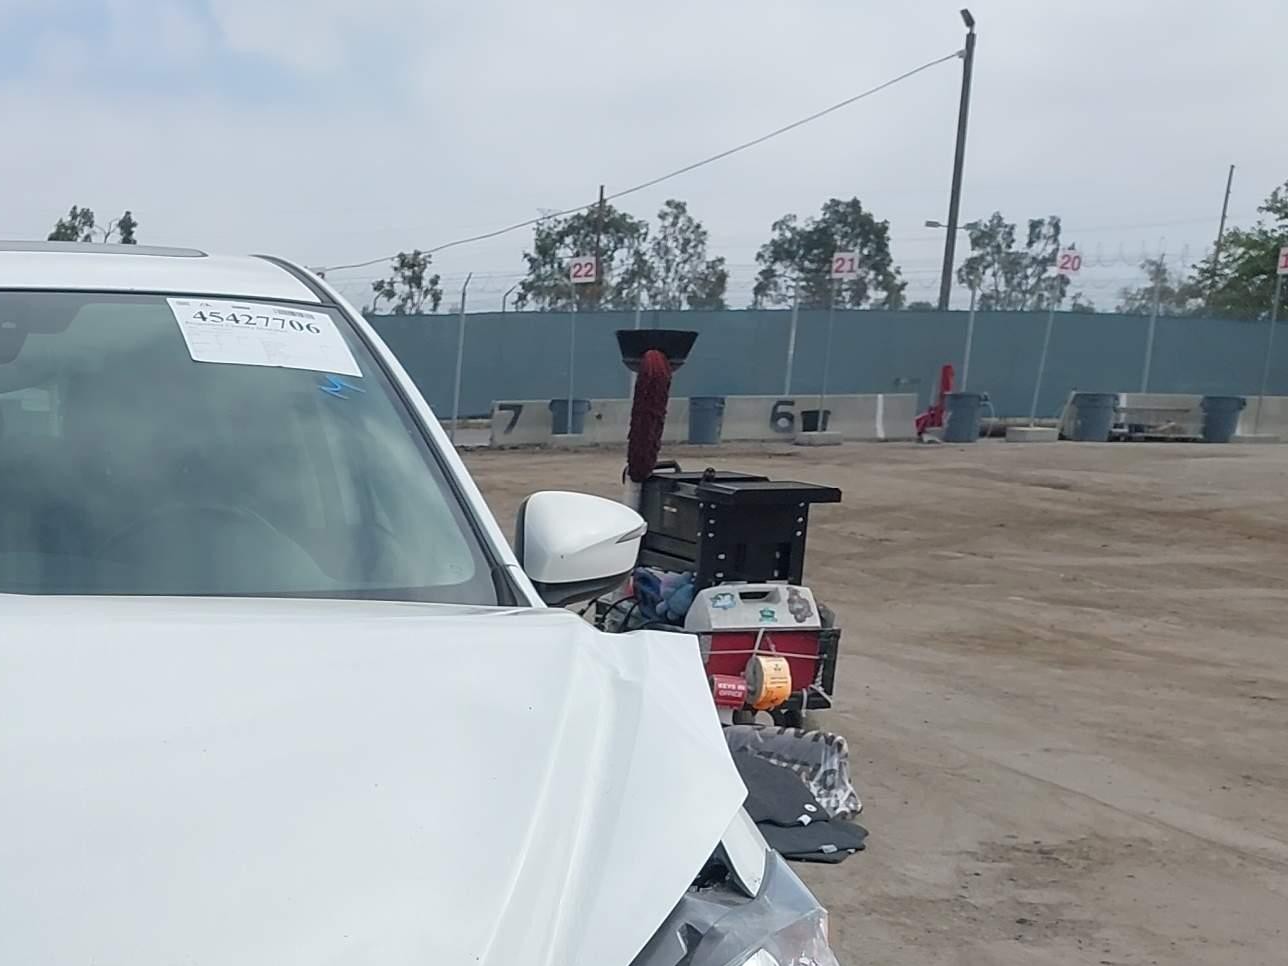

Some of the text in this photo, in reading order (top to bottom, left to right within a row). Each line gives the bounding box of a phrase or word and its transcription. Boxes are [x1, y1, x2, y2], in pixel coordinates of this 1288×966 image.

[573, 262, 594, 278] 22
[835, 257, 855, 273] 21
[1059, 254, 1081, 271] 20
[192, 310, 321, 334] 45427706
[498, 403, 523, 434] 7
[770, 400, 795, 433] 6
